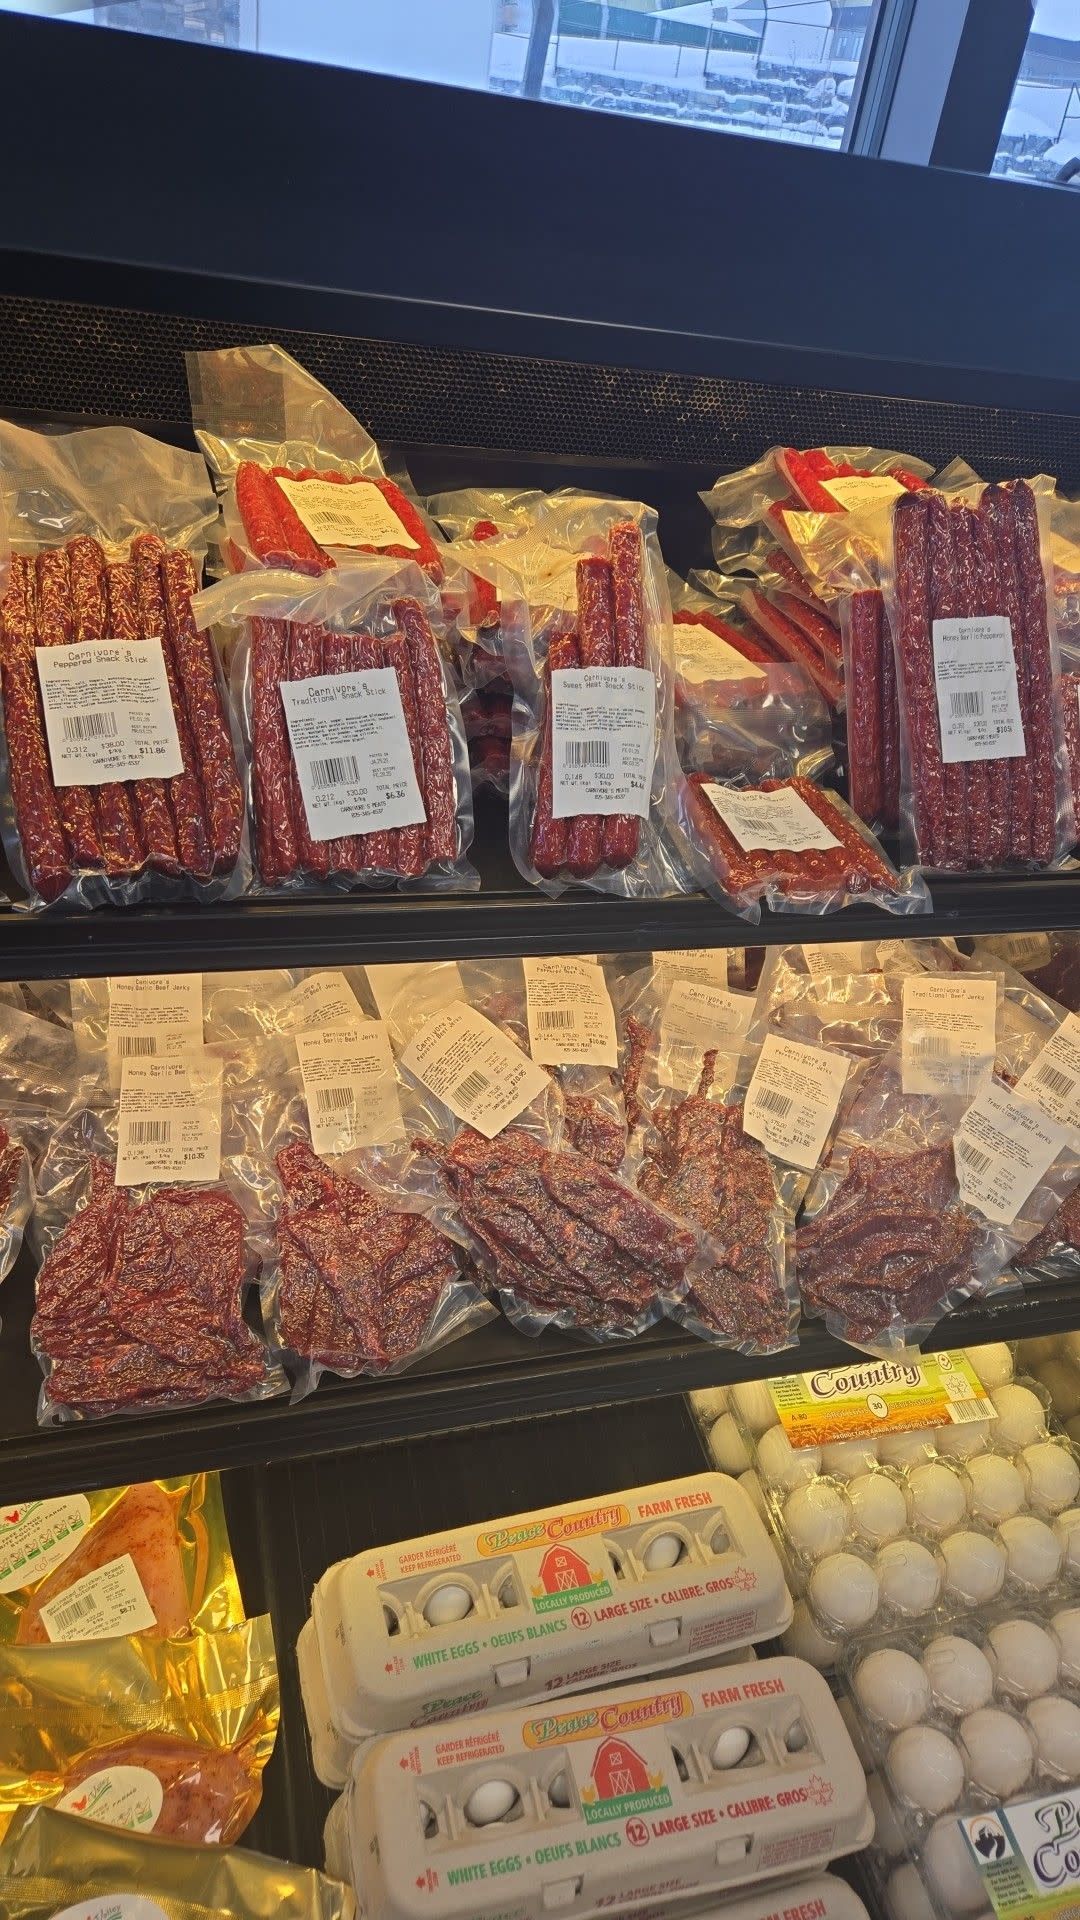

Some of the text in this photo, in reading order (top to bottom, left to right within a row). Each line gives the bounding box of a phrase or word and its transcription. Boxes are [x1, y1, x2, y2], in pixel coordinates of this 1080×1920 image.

[54, 658, 92, 668] Peppered
[124, 656, 148, 664] Stick
[292, 688, 386, 706] Traditional Snack Stick
[386, 790, 406, 800] $6.36
[810, 1362, 920, 1399] Country
[872, 1402, 882, 1410] 30
[637, 1491, 713, 1519] FARM FRESH
[547, 1505, 622, 1540] Country
[399, 1552, 425, 1564] GARDER
[400, 1566, 416, 1574] KEEP
[416, 1554, 462, 1570] REFRIGERATED
[536, 1586, 611, 1611] LOCALLY PRODUCED
[594, 1576, 733, 1623] LARGE SIZE CALIBRE: GROS
[573, 1612, 589, 1626] 12
[412, 1618, 568, 1669] WHITE EGGS OEUFS BLANCS
[545, 1659, 622, 1692] 12 LARGE SIZE
[702, 1678, 785, 1708] FARM FRESH
[600, 1693, 683, 1732] Country
[436, 1742, 464, 1754] GARDER
[437, 1755, 454, 1766] KEEP
[456, 1744, 505, 1762] REFRIGERATED
[586, 1795, 670, 1820] LOCALLY PRODUCED
[652, 1790, 808, 1837] LARGE SIZE CALIBRE: GROS
[628, 1823, 647, 1843] 12
[448, 1832, 622, 1886] WHITE EGGS OEUFS BLANCS
